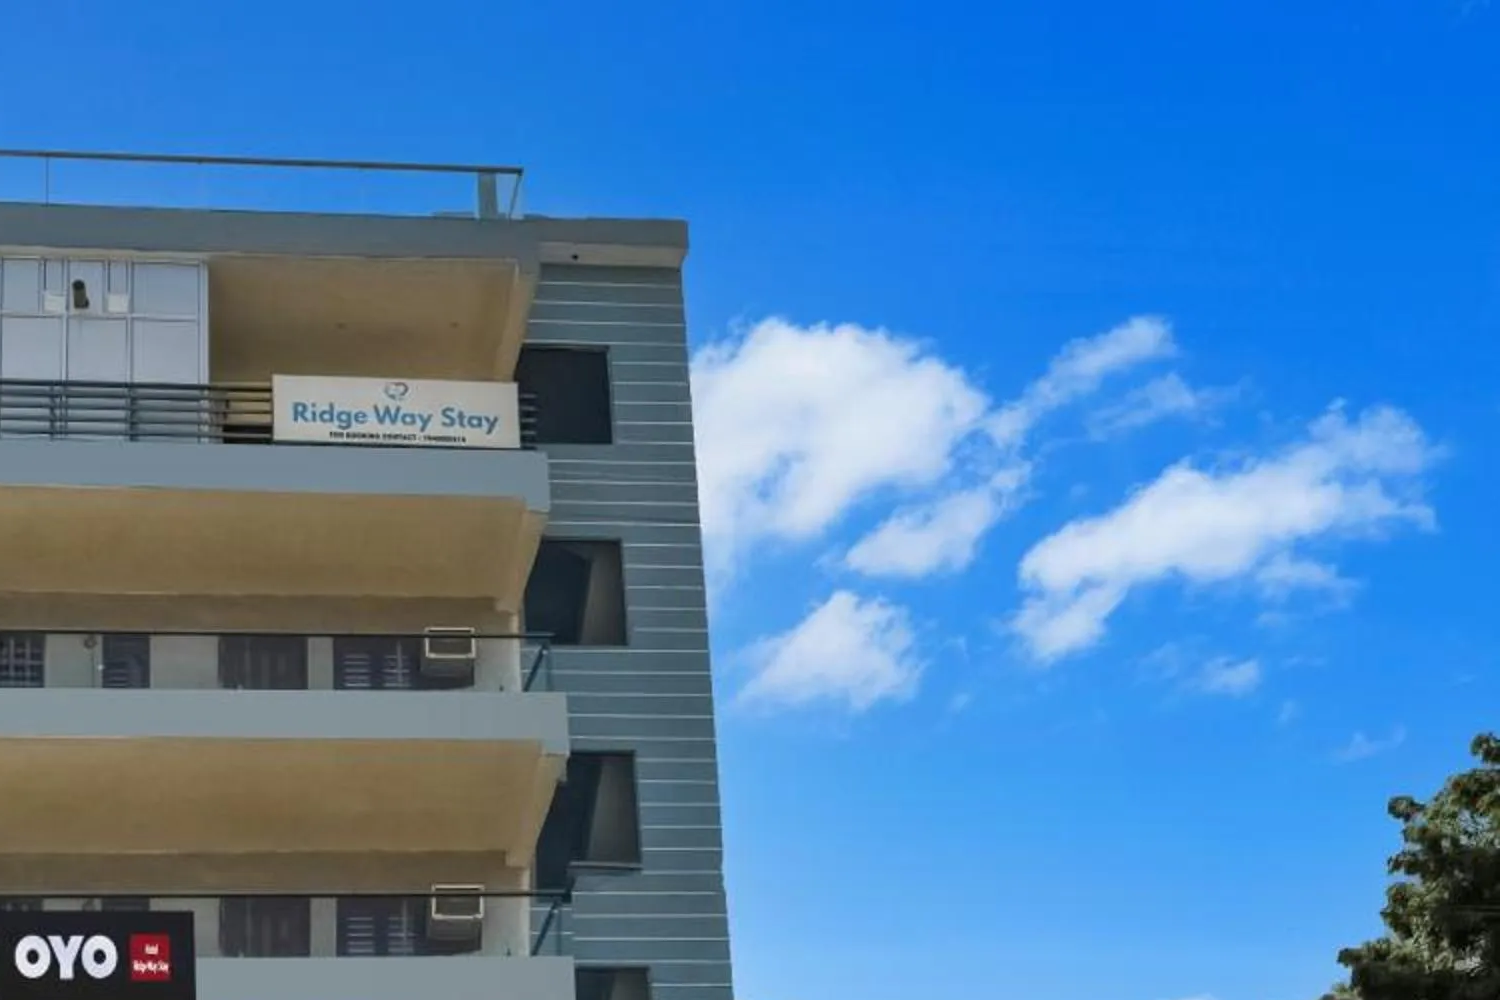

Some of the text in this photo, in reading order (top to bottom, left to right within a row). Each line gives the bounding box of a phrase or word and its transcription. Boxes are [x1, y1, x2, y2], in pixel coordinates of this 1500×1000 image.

[292, 401, 499, 434] Ridge Way Stay
[15, 935, 118, 980] OYO
